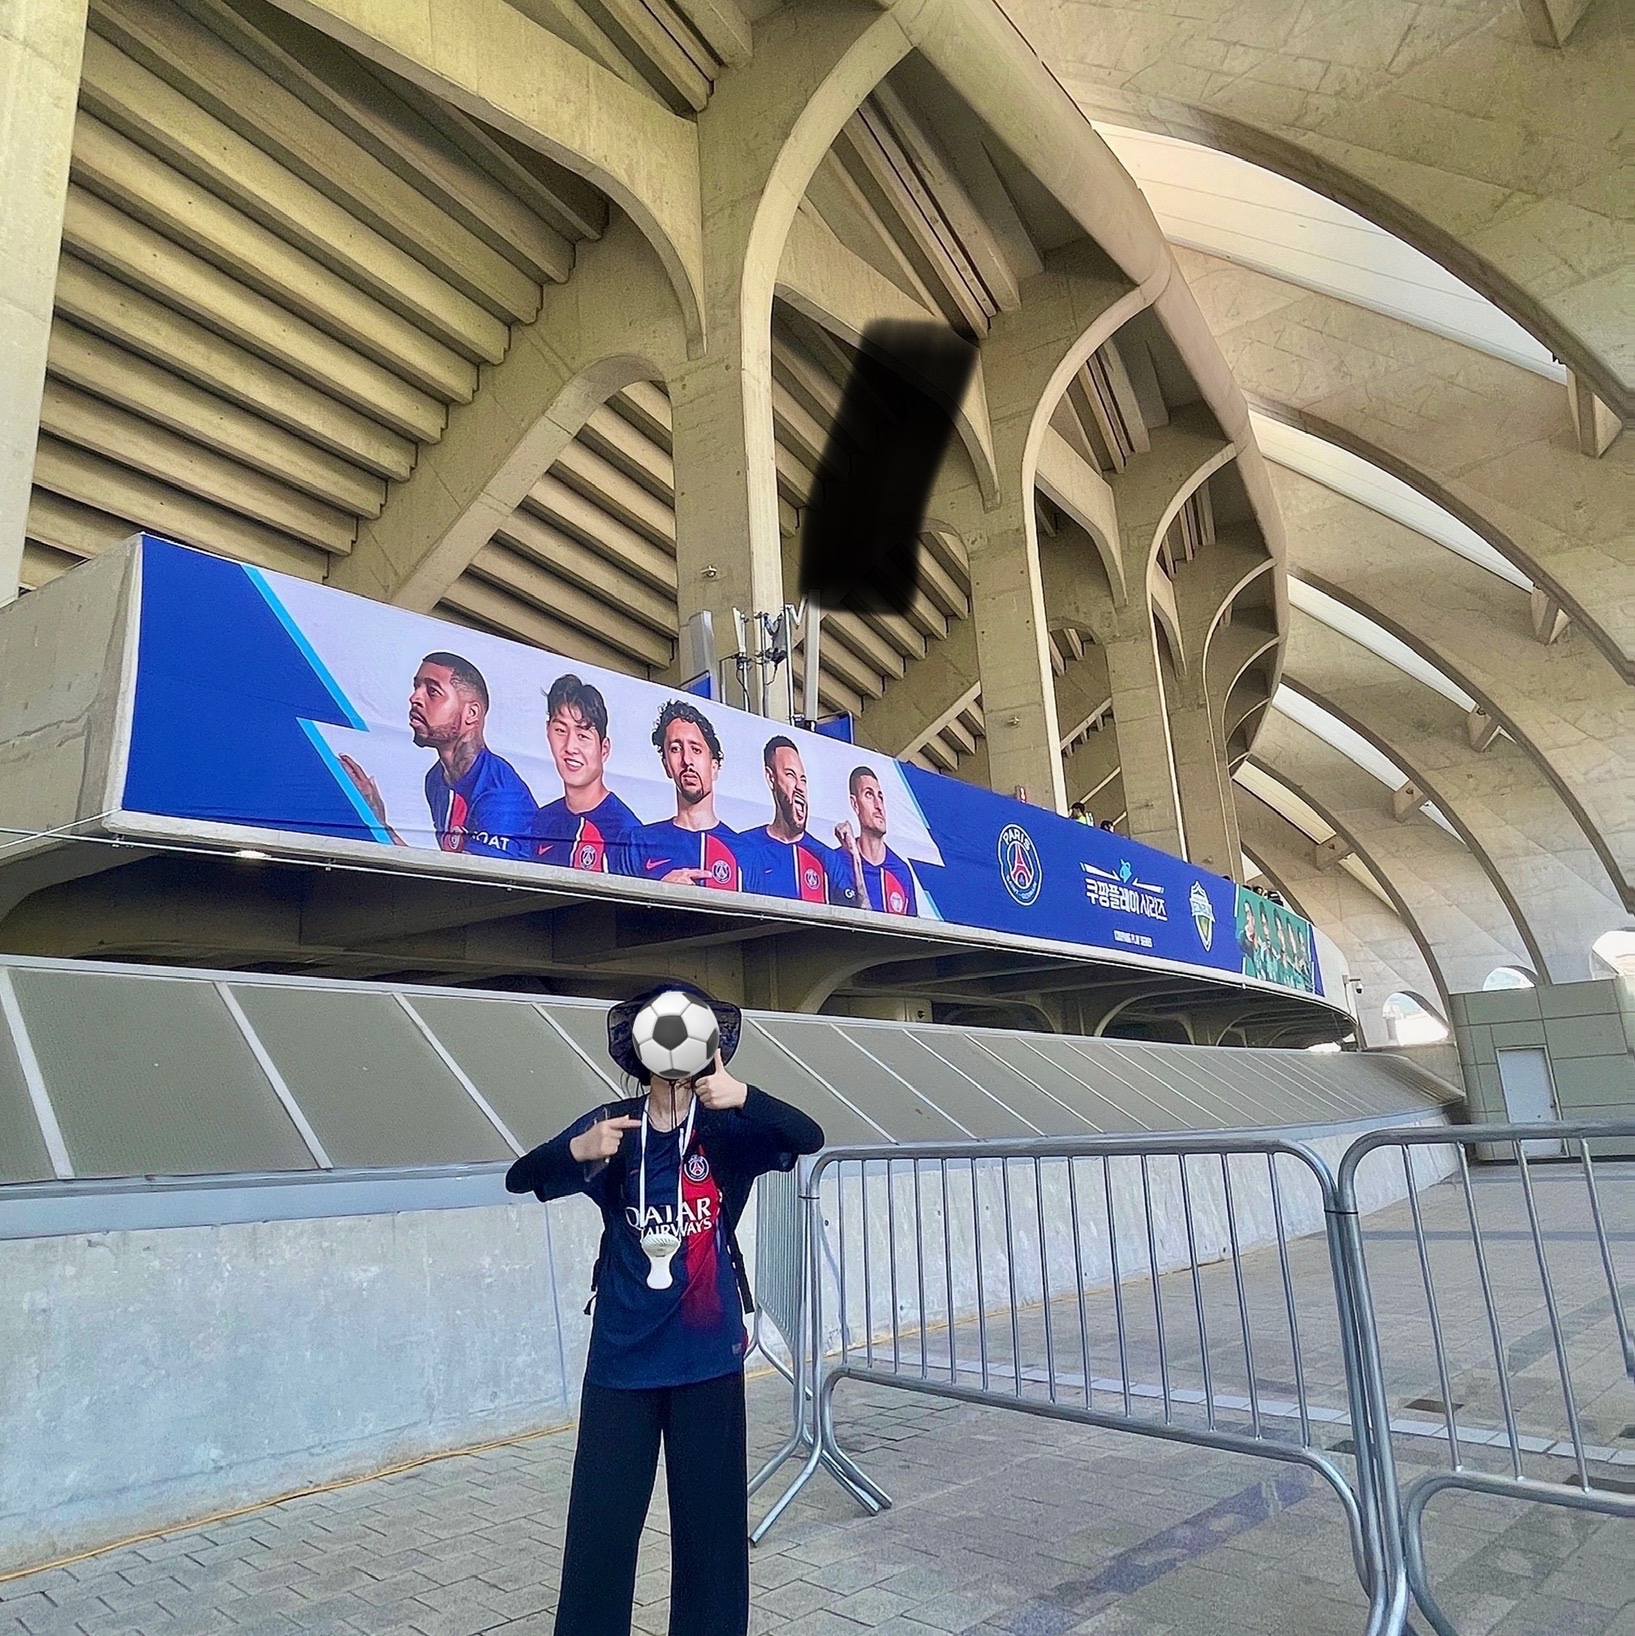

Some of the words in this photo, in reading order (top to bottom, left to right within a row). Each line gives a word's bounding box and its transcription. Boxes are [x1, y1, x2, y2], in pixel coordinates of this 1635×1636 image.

[1002, 828, 1031, 851] PARIS
[1085, 877, 1140, 915] 쿠팡플레이
[1140, 893, 1168, 921] 시리즈
[625, 1197, 712, 1231] QATAR
